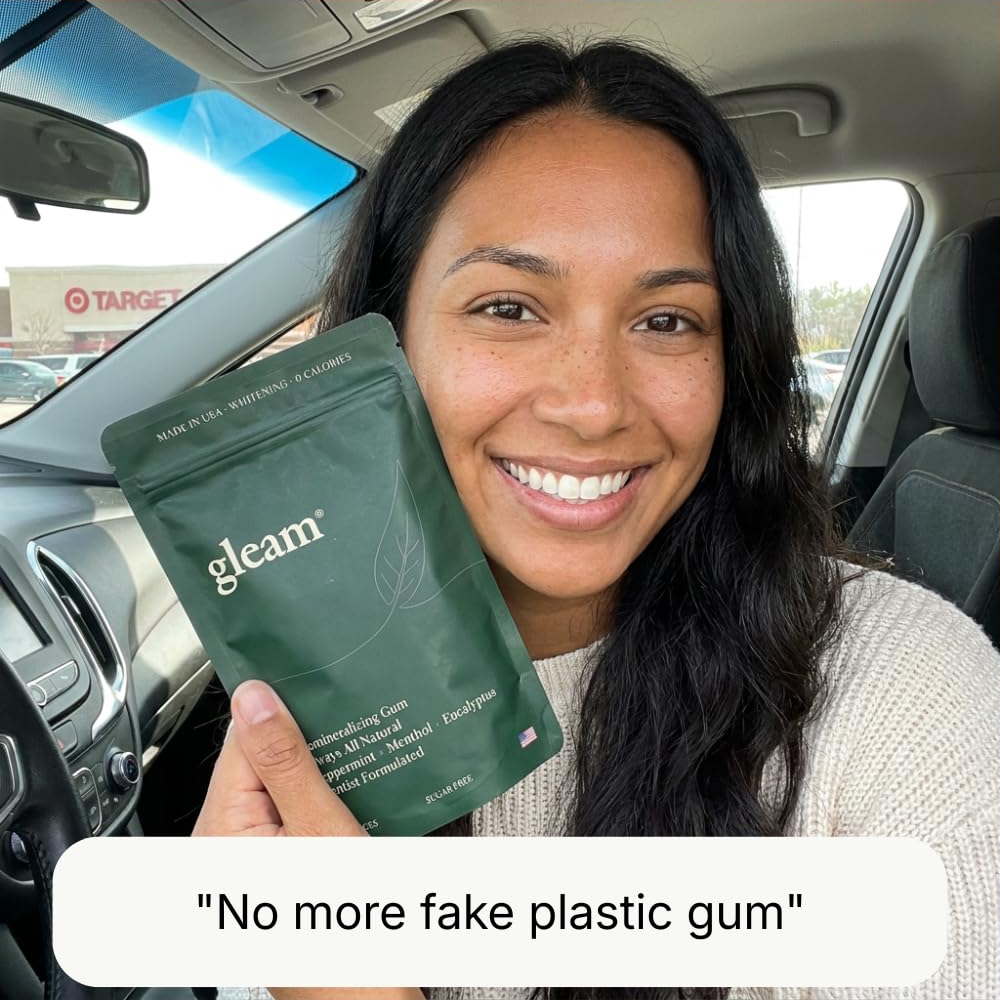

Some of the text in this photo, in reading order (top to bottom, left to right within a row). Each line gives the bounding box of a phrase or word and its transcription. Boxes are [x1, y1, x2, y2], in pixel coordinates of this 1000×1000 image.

[92, 289, 182, 311] TARGET
[188, 417, 201, 430] IN
[228, 380, 288, 410] WHITENING
[380, 698, 409, 718] Gum
[344, 737, 361, 757] All
[361, 719, 403, 746] Natural
[386, 722, 433, 754] Menthol
[361, 745, 424, 783] Formulated
